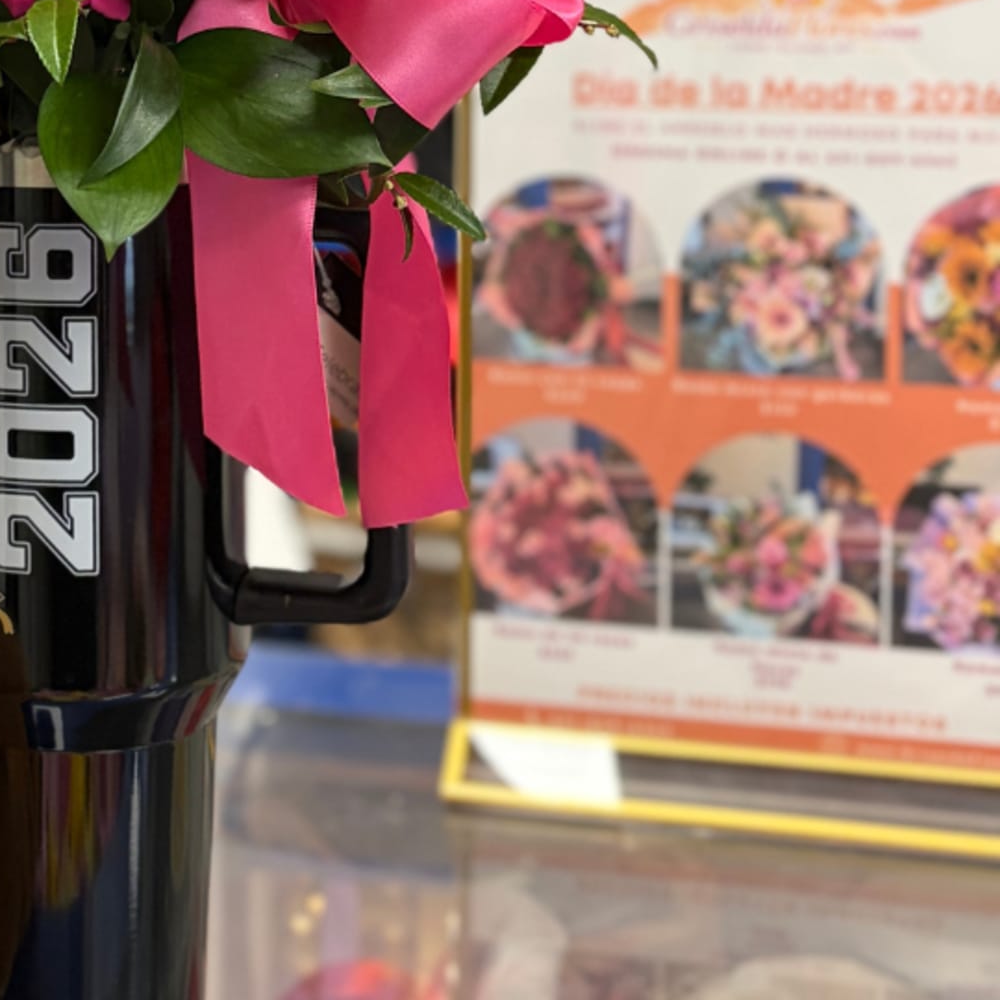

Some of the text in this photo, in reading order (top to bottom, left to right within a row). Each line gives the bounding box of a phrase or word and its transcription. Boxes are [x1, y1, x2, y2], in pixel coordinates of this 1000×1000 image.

[649, 72, 698, 108] de
[708, 72, 748, 109] la
[761, 74, 897, 113] Madre
[909, 79, 1000, 115] 2026
